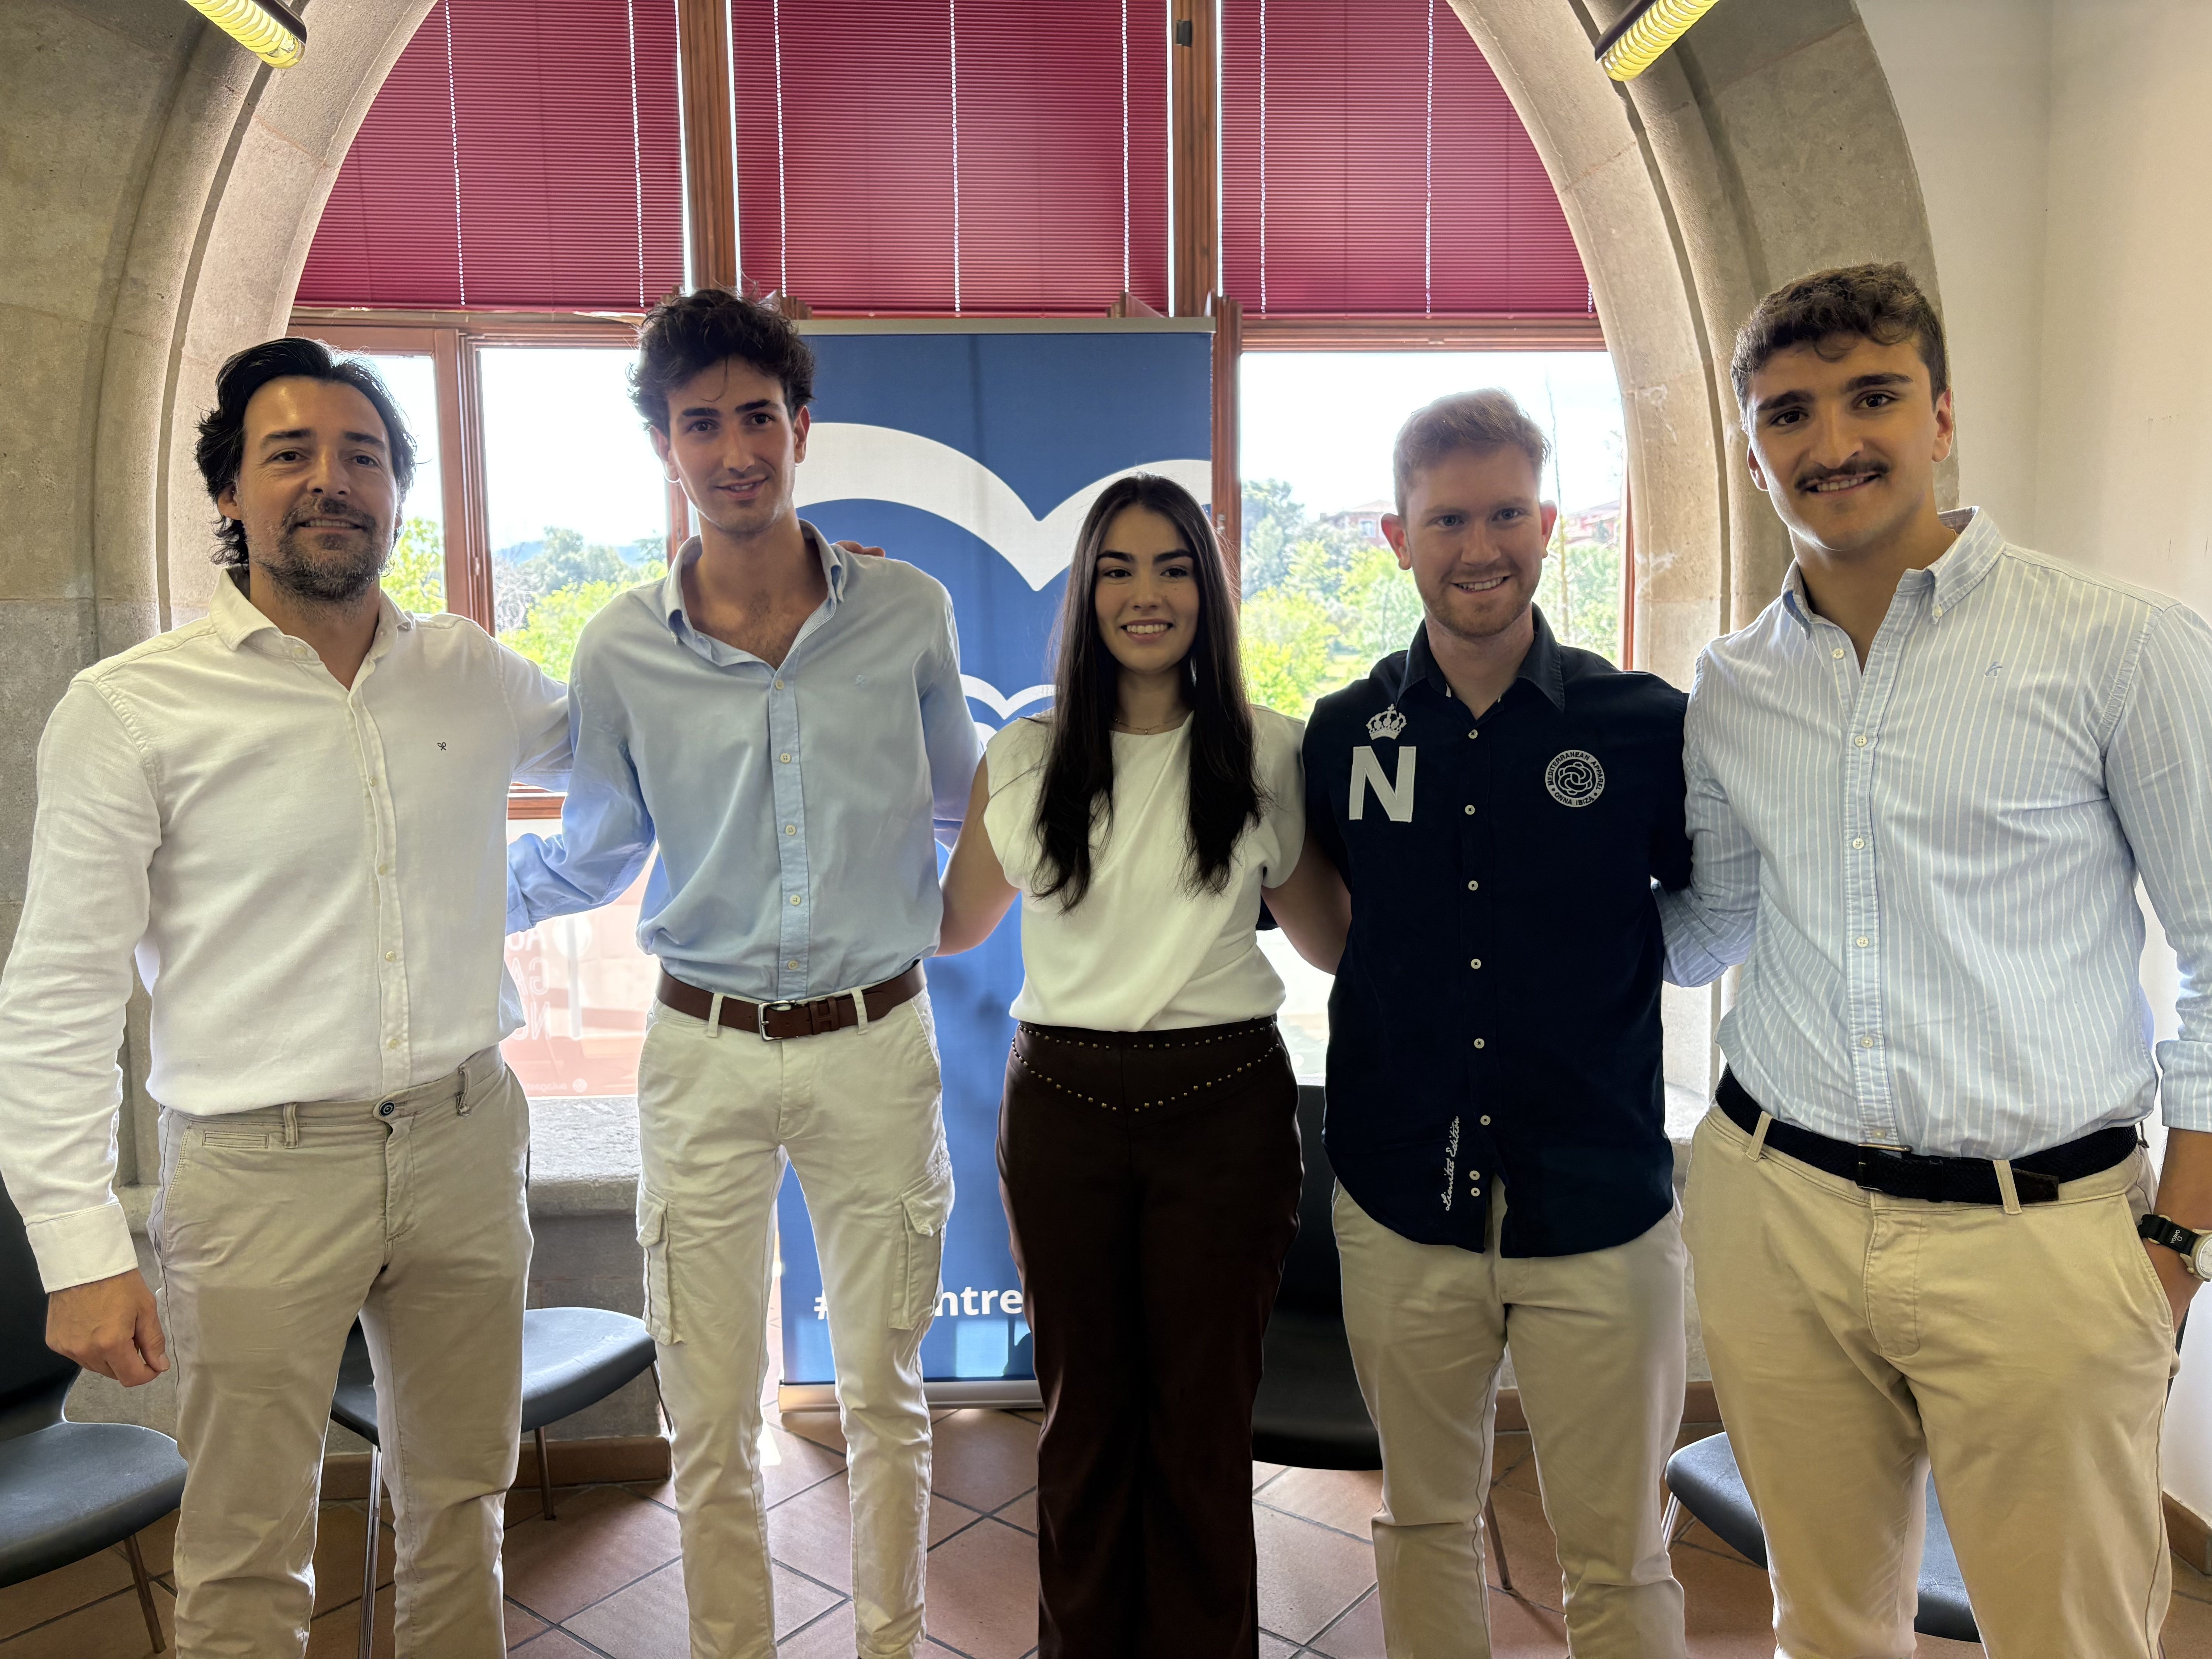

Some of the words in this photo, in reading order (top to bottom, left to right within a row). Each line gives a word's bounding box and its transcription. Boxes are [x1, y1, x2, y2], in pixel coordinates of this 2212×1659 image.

[1349, 745, 1417, 823] N
[1547, 751, 1590, 786] MEDITERRANEAN
[1590, 761, 1604, 790] APPAREL
[1554, 792, 1572, 805] ONNA
[1576, 796, 1595, 806] IBIZA
[1445, 1116, 1460, 1157] Edition
[1441, 1158, 1455, 1211] Limited
[2170, 1230, 2180, 1243] OMEGA
